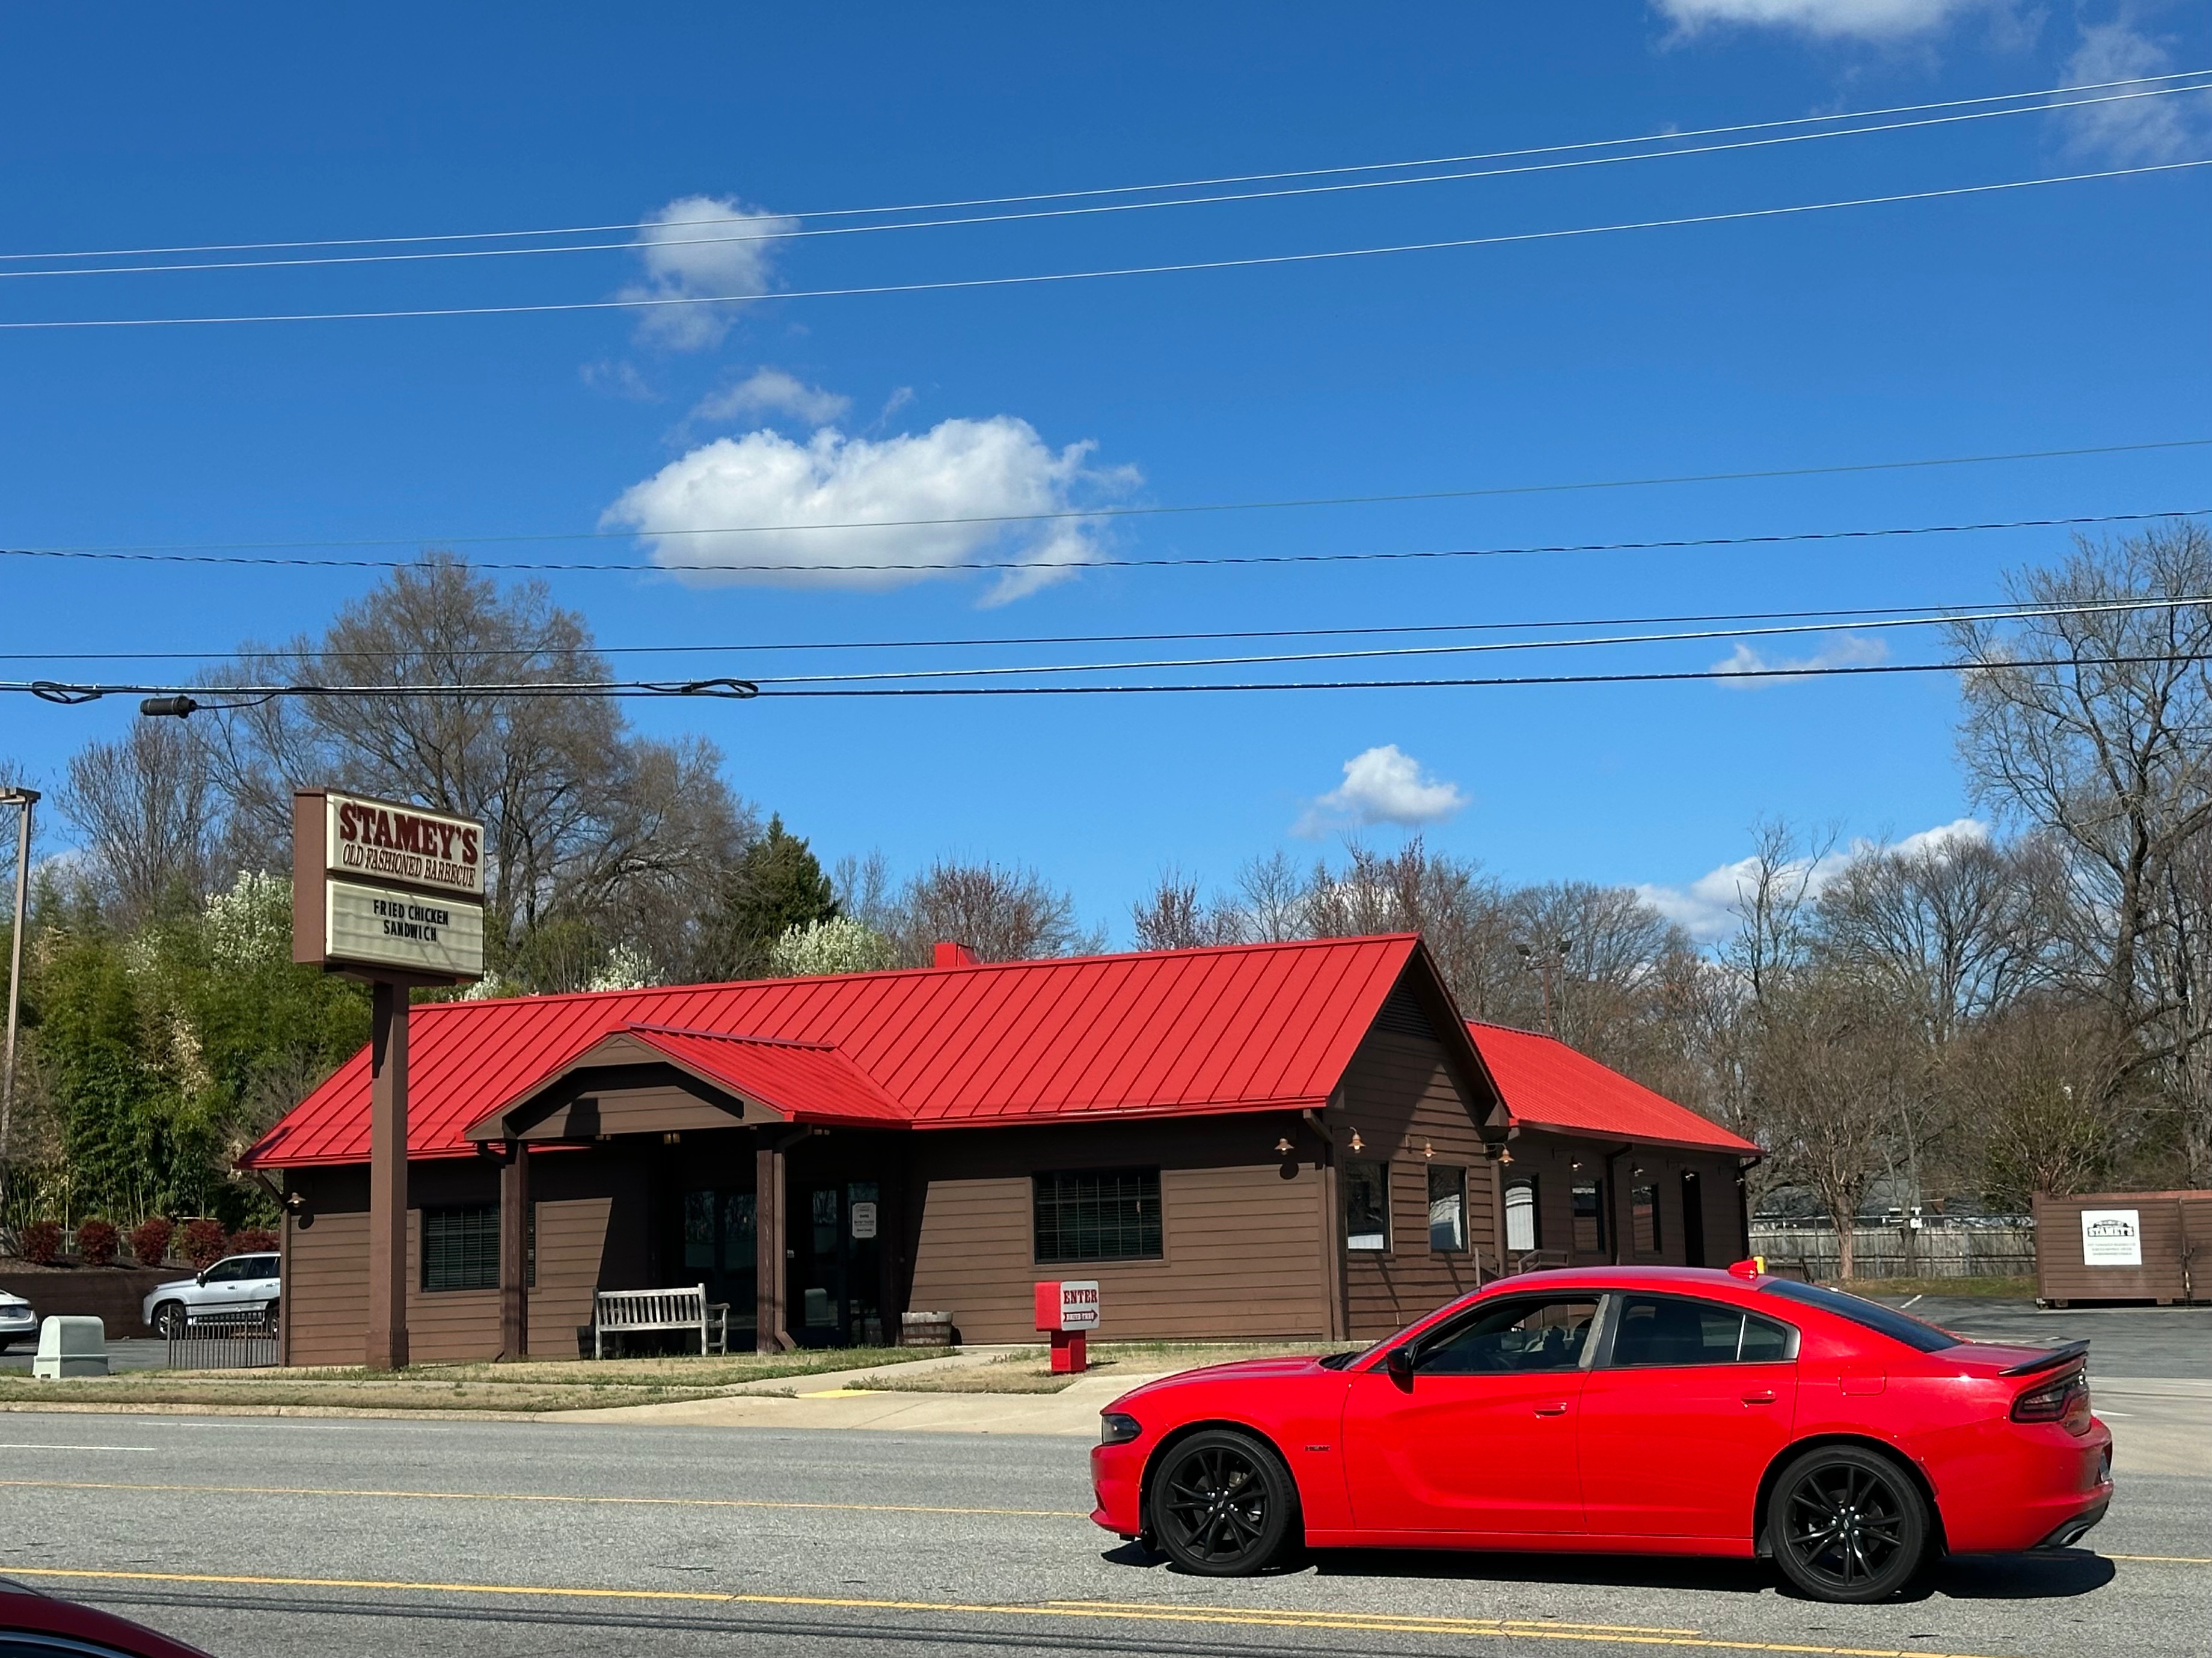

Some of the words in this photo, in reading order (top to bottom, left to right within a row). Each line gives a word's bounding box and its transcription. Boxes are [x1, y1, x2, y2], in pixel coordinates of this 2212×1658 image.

[340, 802, 478, 864] STAMEY'S
[342, 843, 364, 865] OLD
[366, 848, 421, 878] FASHIONED
[424, 858, 476, 887] BARBECUE
[373, 900, 405, 919] FRIED
[408, 905, 449, 926] CHICKEN
[384, 920, 437, 942] SANDWICH
[1063, 1289, 1098, 1305] ENTER
